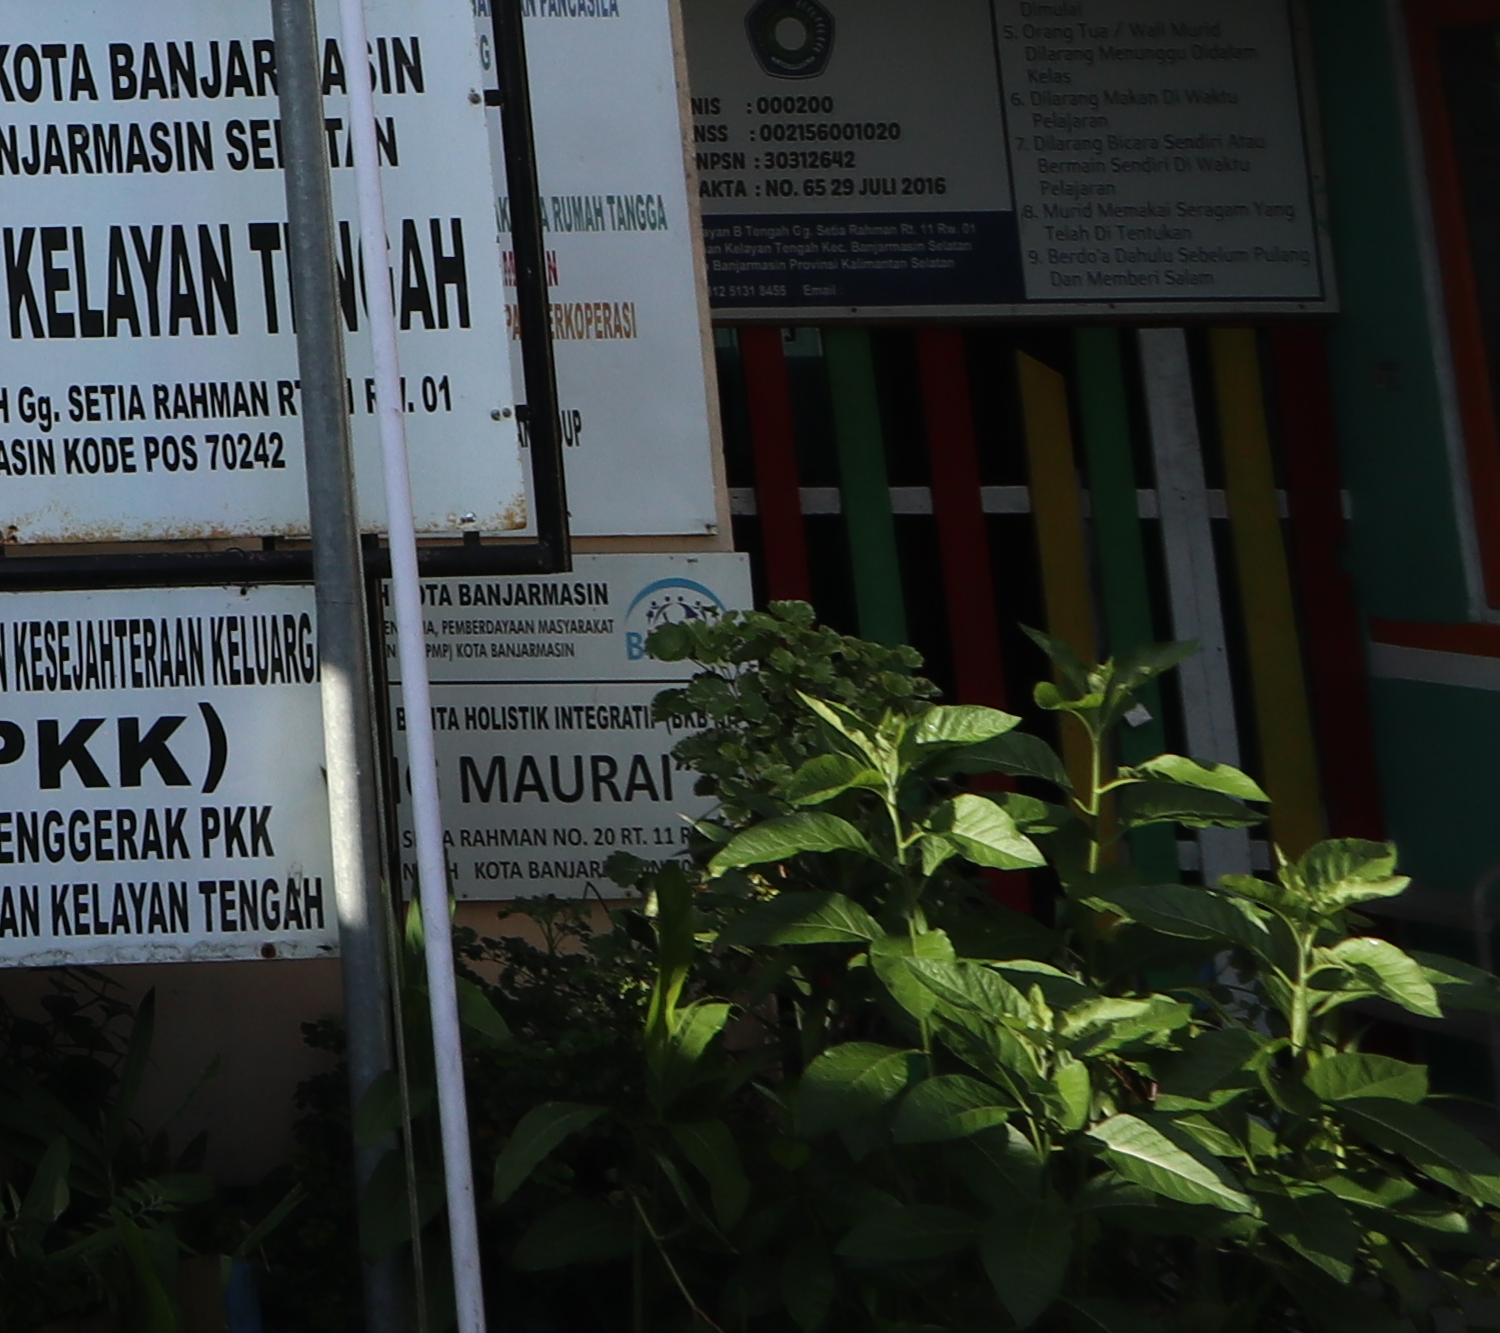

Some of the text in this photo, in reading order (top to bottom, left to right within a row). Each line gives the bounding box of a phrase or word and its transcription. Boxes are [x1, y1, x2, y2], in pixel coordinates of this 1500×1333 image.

[1003, 20, 1222, 43] 5. Orang Tua Wali Murid
[1025, 43, 1258, 66] Dilarang Menunggu Didalam
[108, 36, 425, 101] BANJARAIN
[1027, 67, 1071, 84] Kelas
[691, 95, 834, 115] NIS 000200
[1010, 88, 1238, 110] 6. Dilarang Makan Di Waktu
[693, 122, 902, 143] NSS 002156001020
[1032, 112, 1108, 133] Pelajaran
[225, 116, 399, 171] SETN
[1015, 133, 1266, 156] 7. Dilarang Bicara Sendiri Atau
[696, 149, 857, 170] NPSN 30312642
[1037, 154, 1250, 174] Bermain Sendiri Di Waktu
[699, 176, 947, 198] AKTA NO. 65 29 JULI 2016
[1040, 179, 1116, 201] Pelajaran
[554, 194, 606, 233] RUMAH
[606, 194, 669, 232] TANGGA
[1042, 201, 1092, 219] Murid
[1097, 200, 1172, 218] Memakai
[1176, 199, 1249, 222] Seragam
[1252, 200, 1295, 222] Yang
[1044, 222, 1193, 241] Telah Di Tentukan
[850, 240, 925, 256] Banjarmasin
[1028, 245, 1311, 268] 9. Berdo'a Dahulu Sebelum Pulang
[713, 259, 787, 273] Banjarmasin
[789, 258, 839, 271] Provinsi
[841, 257, 908, 270] Kalimantan
[3, 223, 239, 342] KELAYAN
[248, 217, 471, 335] TNAH
[1050, 268, 1215, 287] Dan Memberi Salam
[803, 283, 836, 296] Email
[548, 301, 637, 340] ERKOPERASI
[17, 383, 61, 433] Gg.
[68, 383, 147, 423] SETIA
[153, 380, 271, 420] RAHMAN
[421, 375, 453, 413] 01
[64, 435, 137, 476] KODE
[144, 434, 198, 472] POS
[206, 431, 286, 471] 70242
[458, 582, 610, 607] BANJARMASIN
[441, 619, 536, 636] PEMBERDAYAAN
[538, 618, 615, 634] MASYARAKAT
[13, 617, 205, 692] KESEJAHTERAAN
[455, 643, 488, 658] KOTA
[490, 642, 576, 658] BANJARMASIN
[396, 706, 459, 731] BITA
[464, 705, 550, 731] HOLISTIK
[202, 805, 275, 860] PKK
[460, 828, 547, 848] RAHMAN
[551, 827, 588, 847] NO.
[593, 827, 616, 846] 20
[621, 827, 648, 846] RT.
[653, 826, 675, 845] 11
[474, 860, 523, 881] KOTA
[50, 881, 190, 937] KELAYAN
[197, 876, 326, 932] TENGAH
